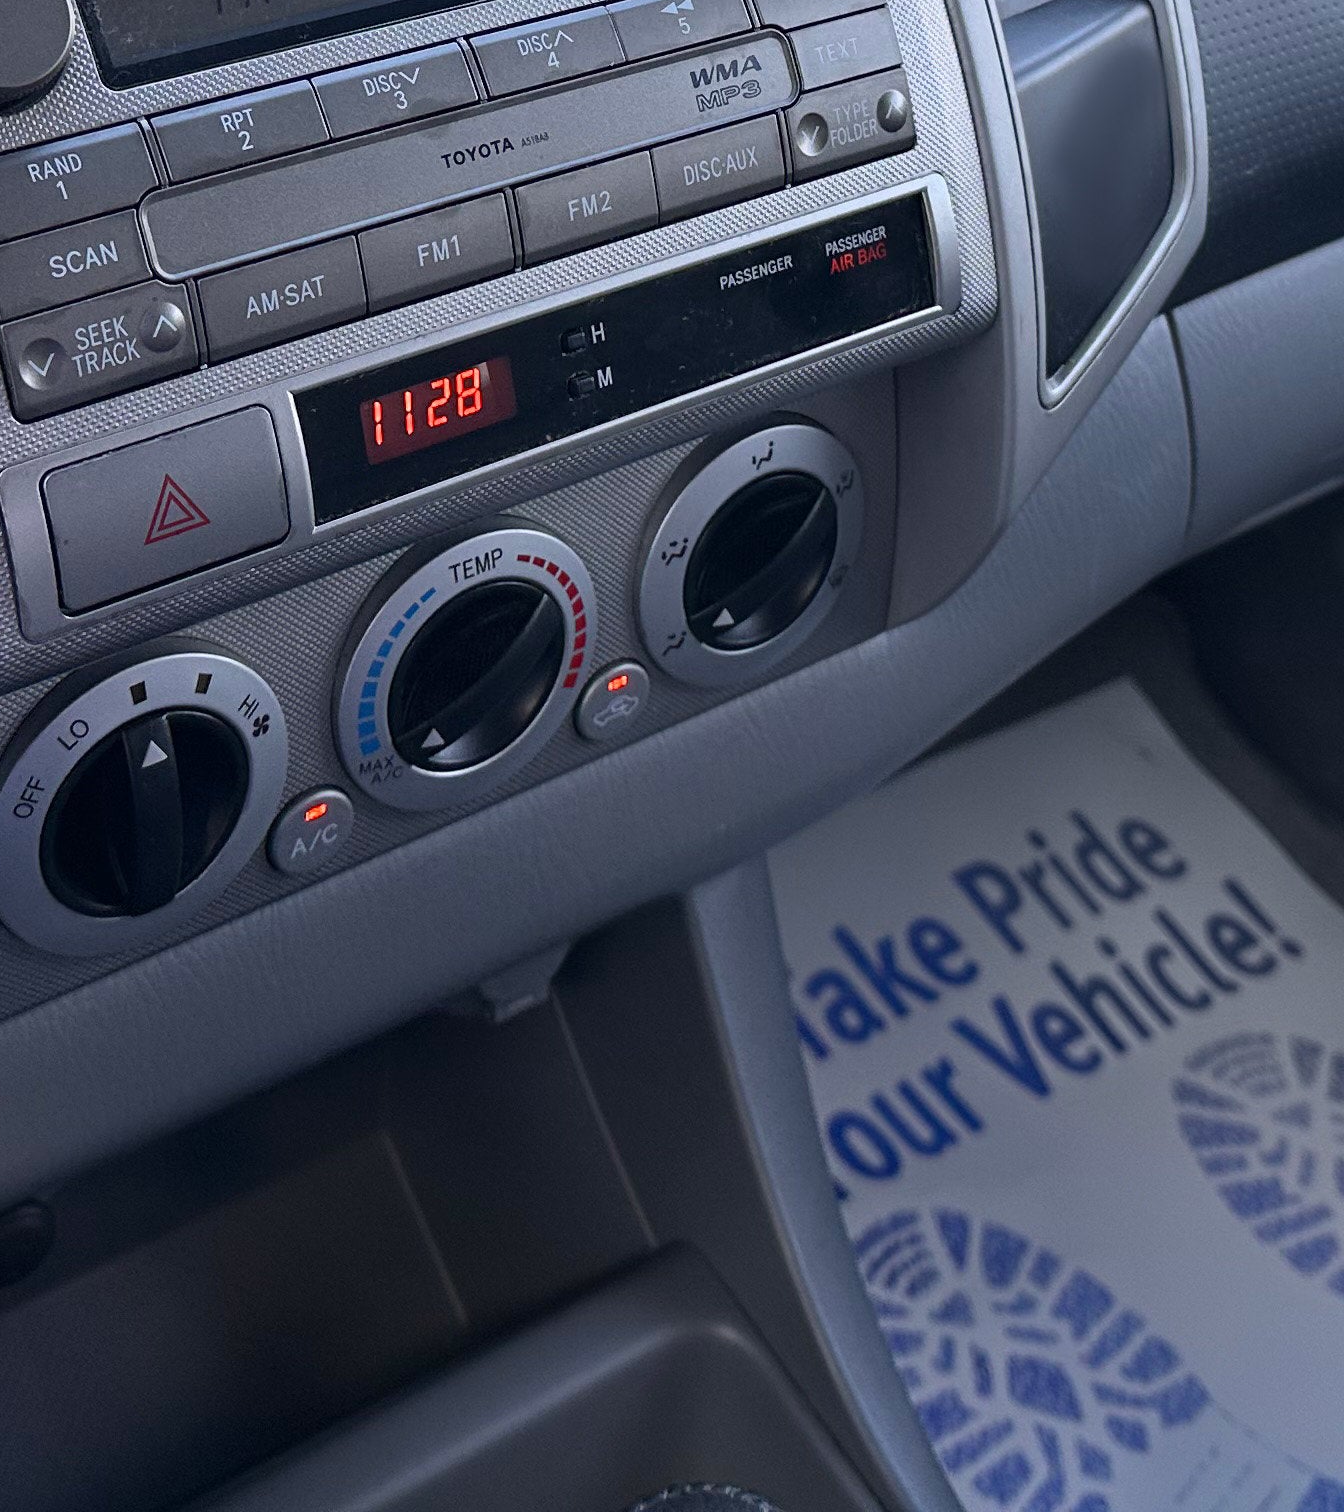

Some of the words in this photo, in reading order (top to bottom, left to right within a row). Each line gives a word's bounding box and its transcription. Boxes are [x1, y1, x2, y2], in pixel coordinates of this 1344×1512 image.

[680, 18, 691, 34] 5
[547, 52, 560, 68] 4
[815, 38, 858, 64] TEXT
[690, 54, 763, 88] WMA
[395, 91, 408, 109] 3
[697, 80, 762, 111] MP3
[220, 109, 255, 133] RPT
[833, 102, 870, 122] TYPE
[240, 131, 254, 151] 2
[830, 120, 878, 149] FOLDER
[27, 153, 83, 183] RAND
[441, 138, 514, 168] TOYOTA
[56, 181, 69, 200] 1
[567, 190, 613, 222] FM2
[417, 234, 462, 267] FM1
[825, 225, 887, 256] PASSENGER
[49, 240, 118, 279] SCAN
[719, 255, 793, 290] PASSENGER
[829, 253, 854, 275] AIR
[858, 243, 887, 265] BAG
[74, 315, 128, 351] SEEK
[591, 322, 605, 344] H
[71, 338, 141, 377] TRACK
[597, 366, 613, 388] M
[448, 549, 504, 583] TEMP
[238, 693, 259, 719] HI
[57, 718, 90, 752] LO
[358, 755, 396, 776] MAX
[371, 766, 404, 785] A/C
[13, 775, 46, 819] OFF
[291, 823, 338, 859] A/C
[797, 916, 981, 1061] ake
[952, 808, 1188, 955] Pride
[826, 1053, 985, 1201] our
[951, 877, 1303, 1099] Vehicle!
